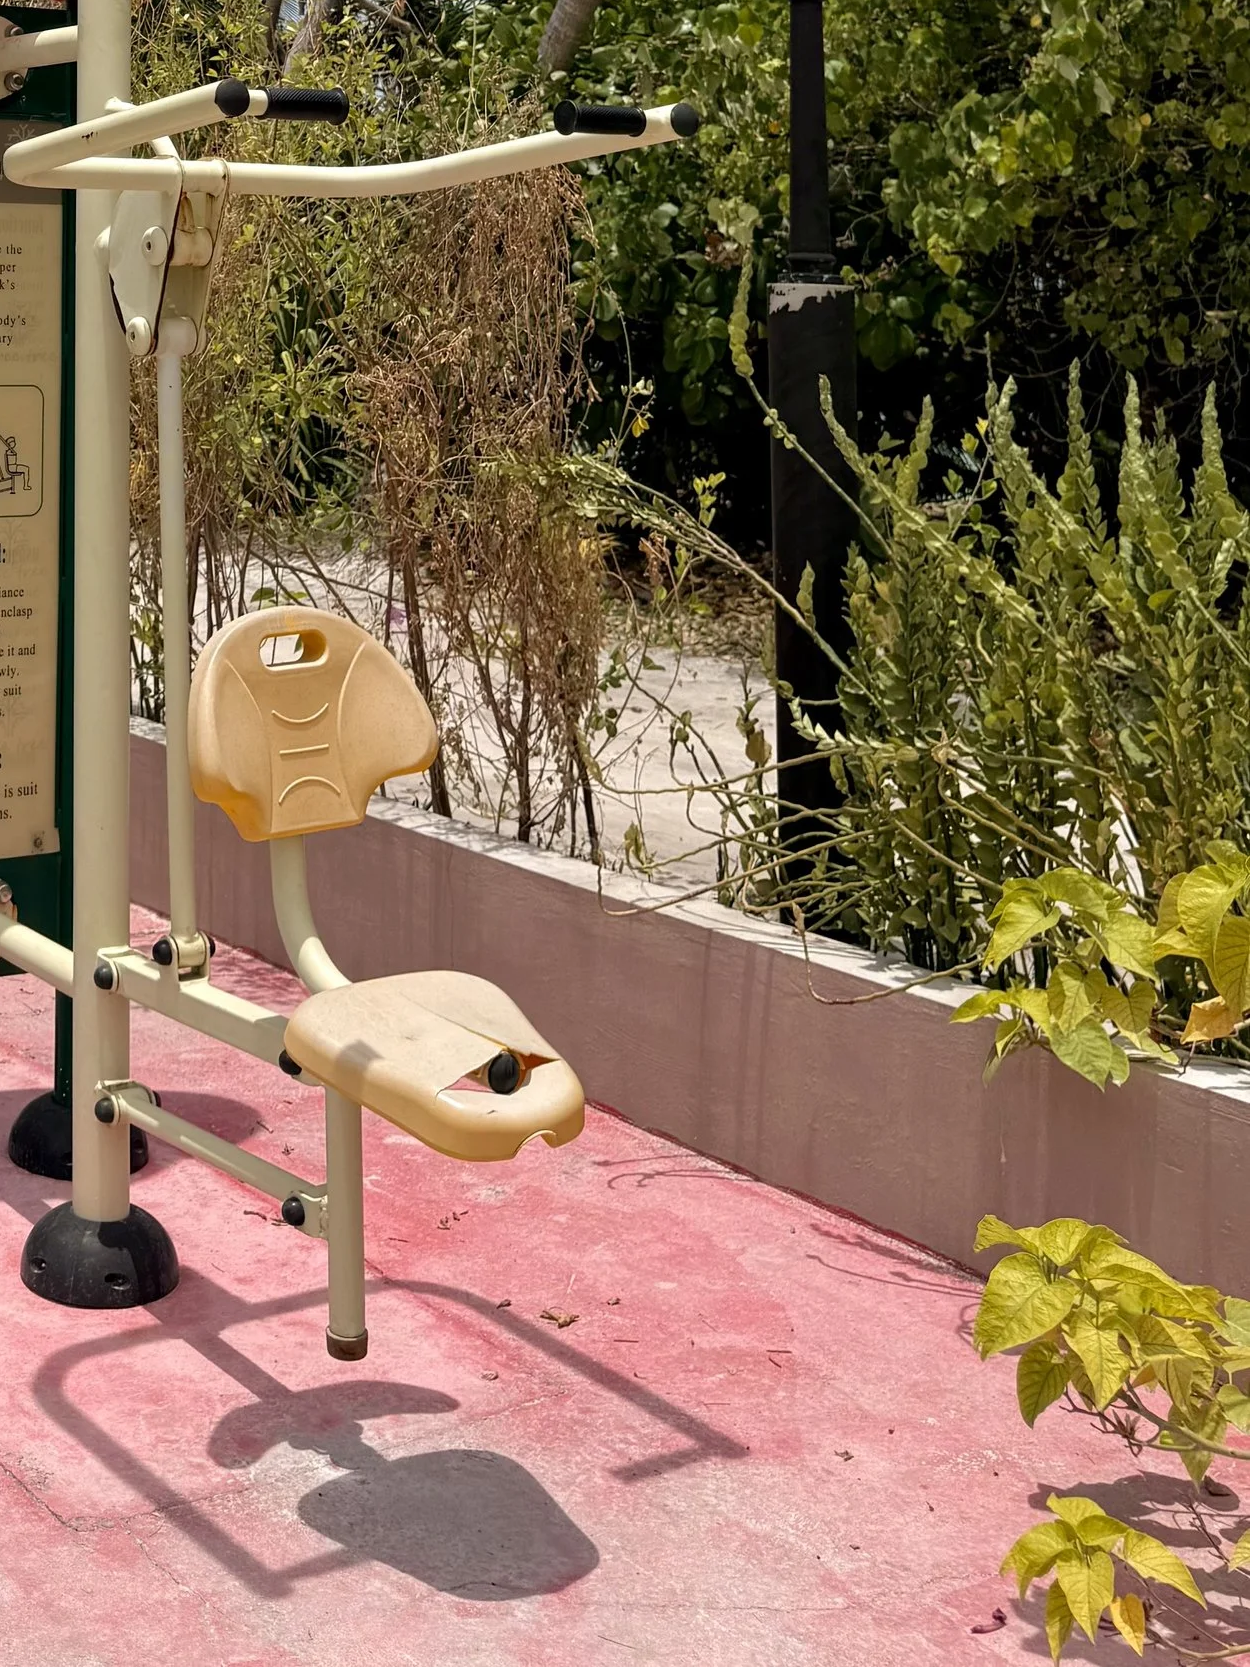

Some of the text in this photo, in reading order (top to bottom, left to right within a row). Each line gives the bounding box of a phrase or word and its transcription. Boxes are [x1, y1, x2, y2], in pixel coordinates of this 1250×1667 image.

[6, 243, 23, 255] the
[7, 645, 15, 657] it
[17, 643, 36, 656] and
[3, 684, 22, 697] suit
[3, 784, 14, 799] is
[17, 781, 39, 797] suit
